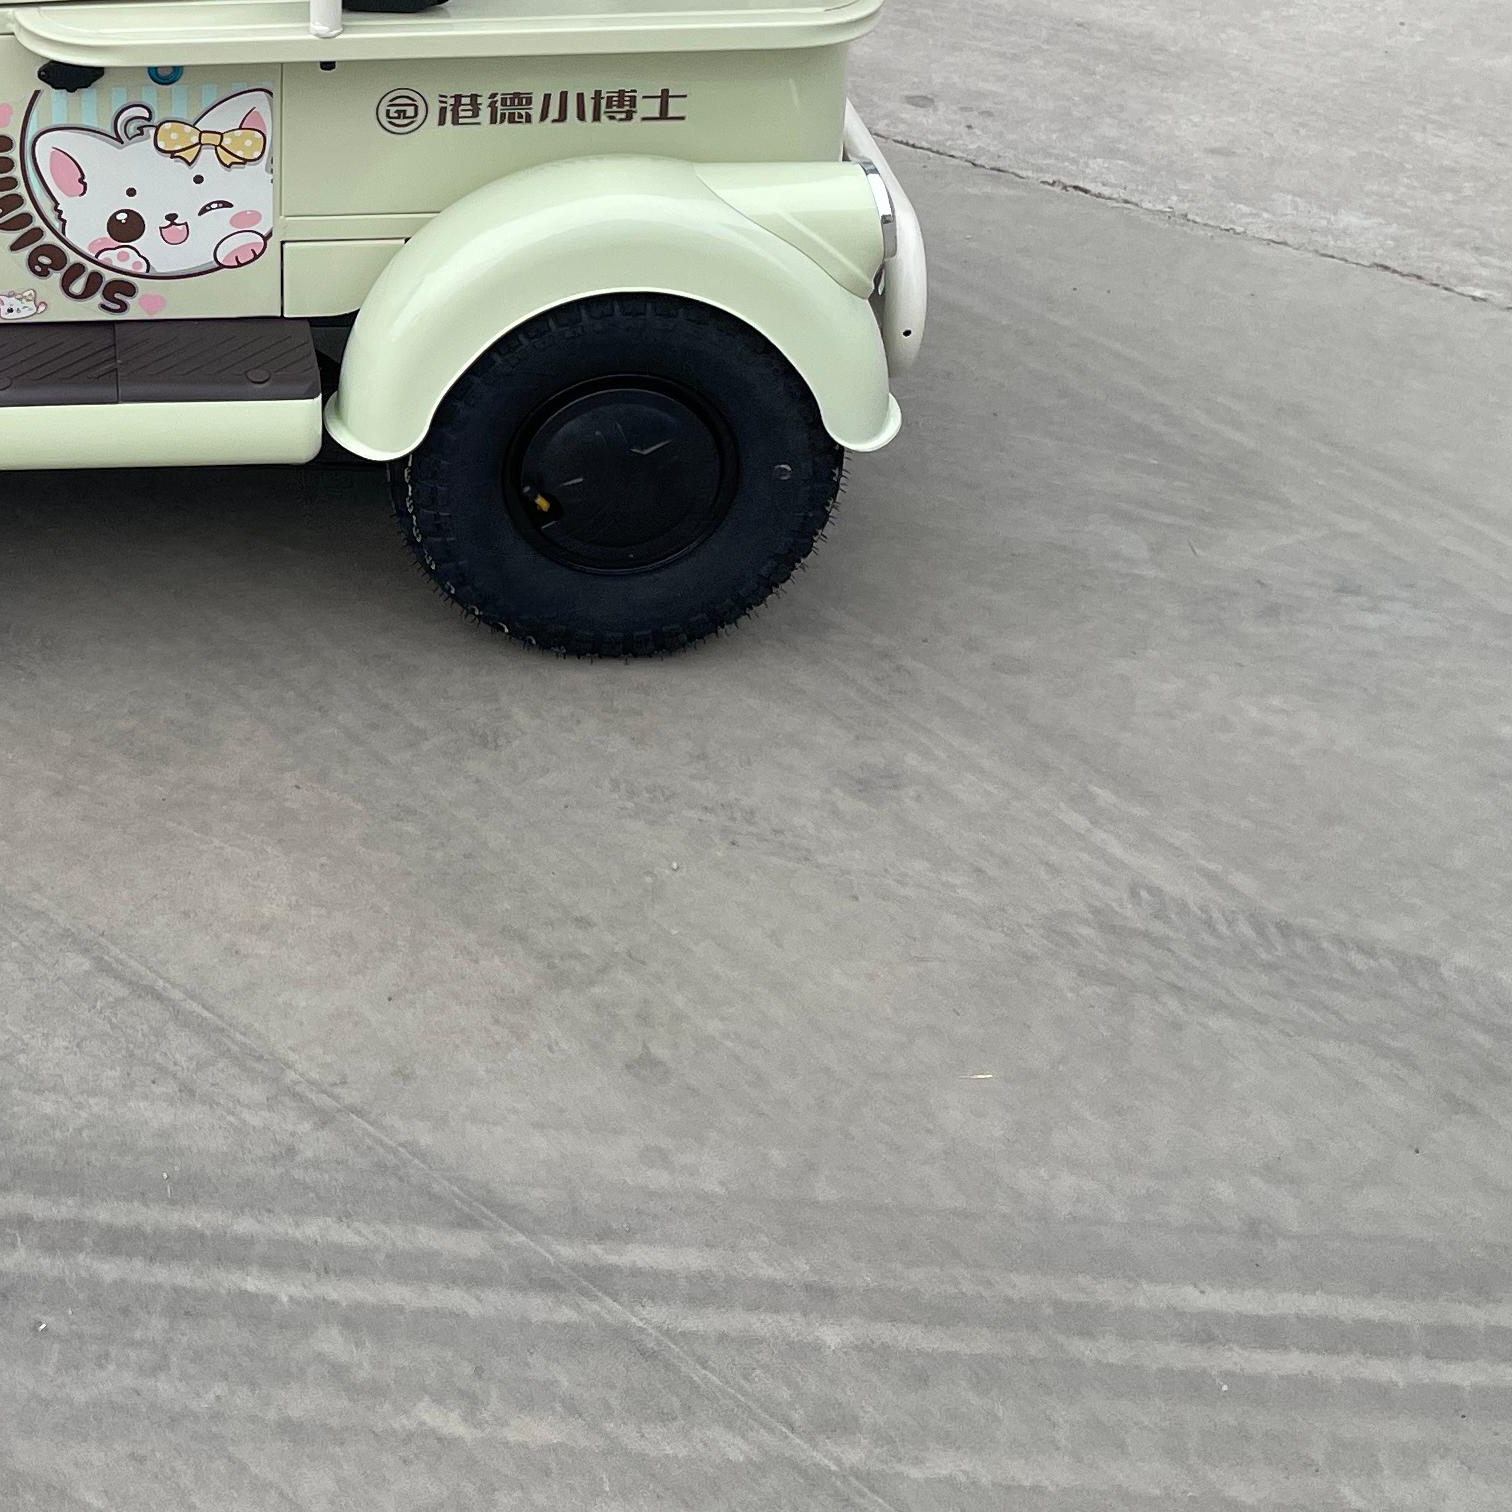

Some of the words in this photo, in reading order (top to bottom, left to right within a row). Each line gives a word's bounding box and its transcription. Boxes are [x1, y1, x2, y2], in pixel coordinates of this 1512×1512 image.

[437, 87, 688, 127] 港德小博士
